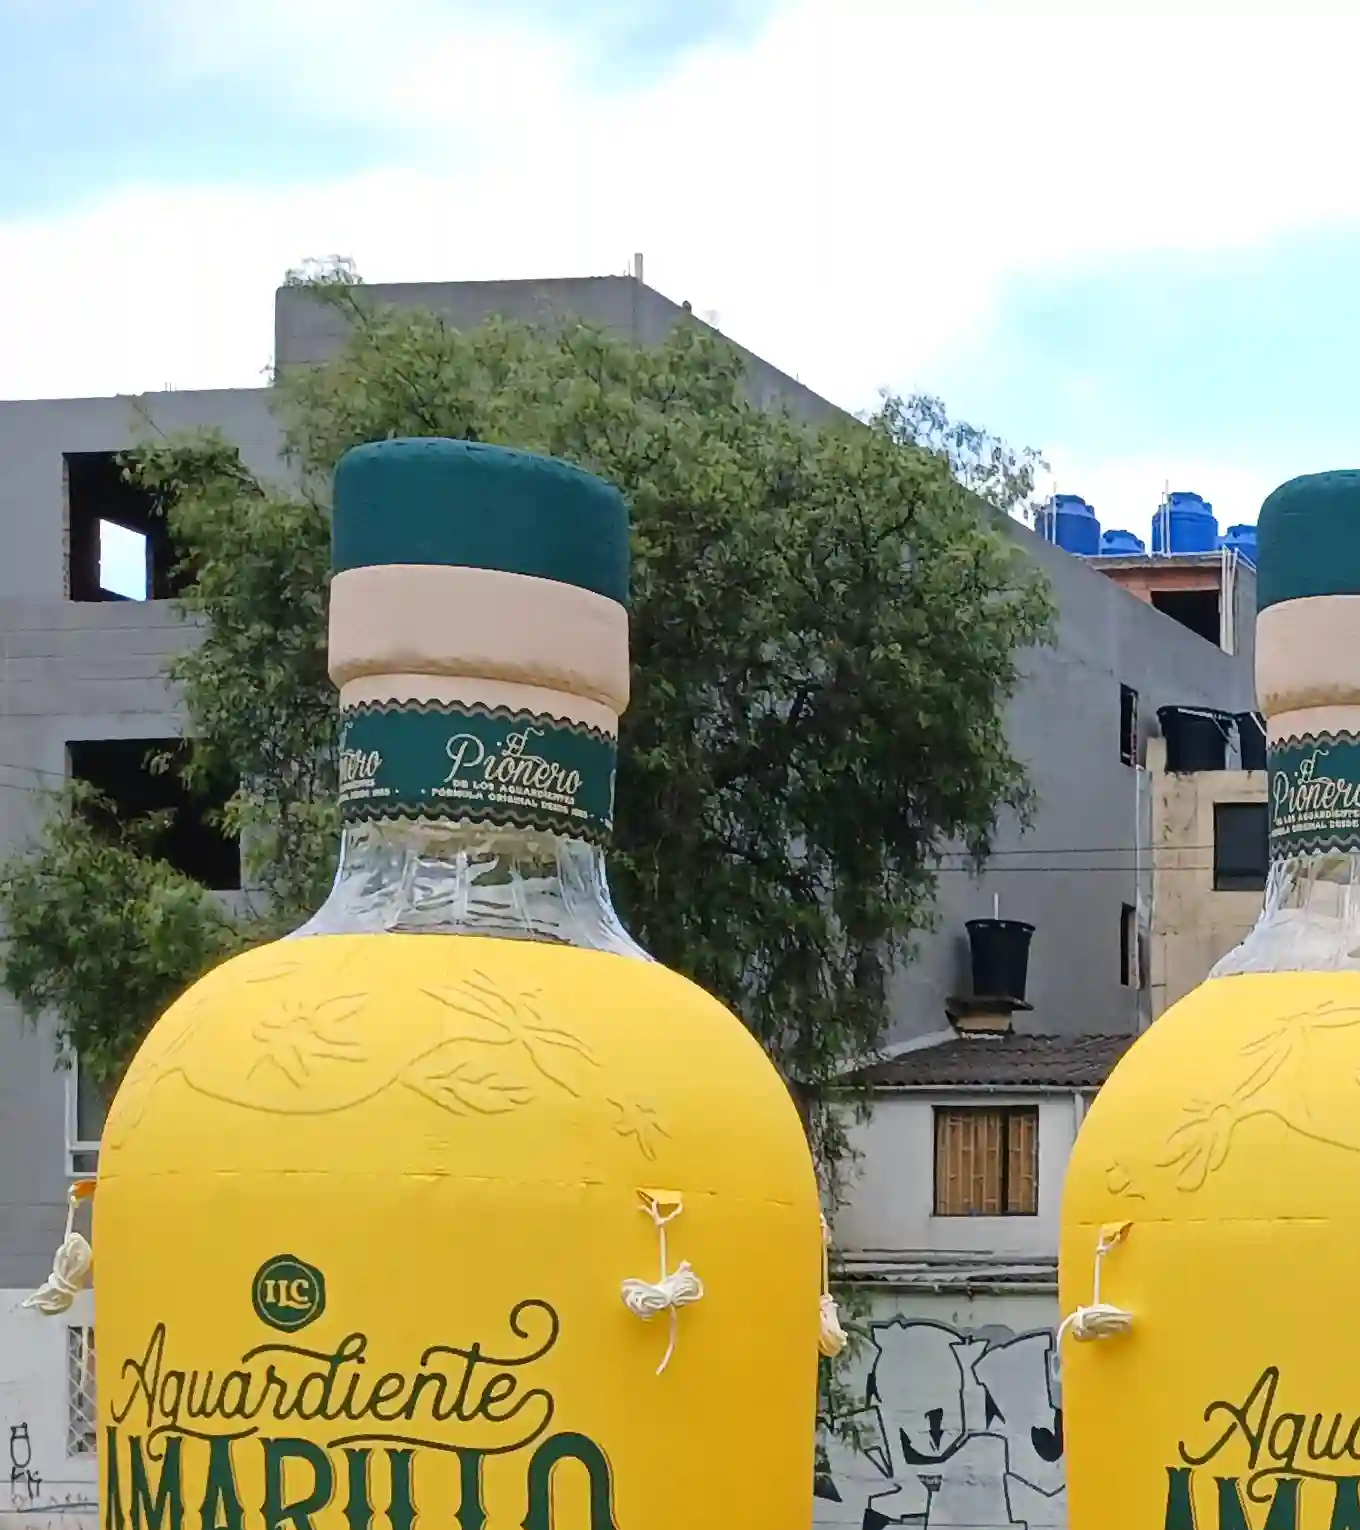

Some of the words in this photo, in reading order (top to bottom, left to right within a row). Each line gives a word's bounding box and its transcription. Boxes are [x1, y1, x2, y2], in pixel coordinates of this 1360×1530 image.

[444, 733, 584, 795] Pionero
[265, 1278, 312, 1310] ILC
[110, 1299, 560, 1461] Aguardiente
